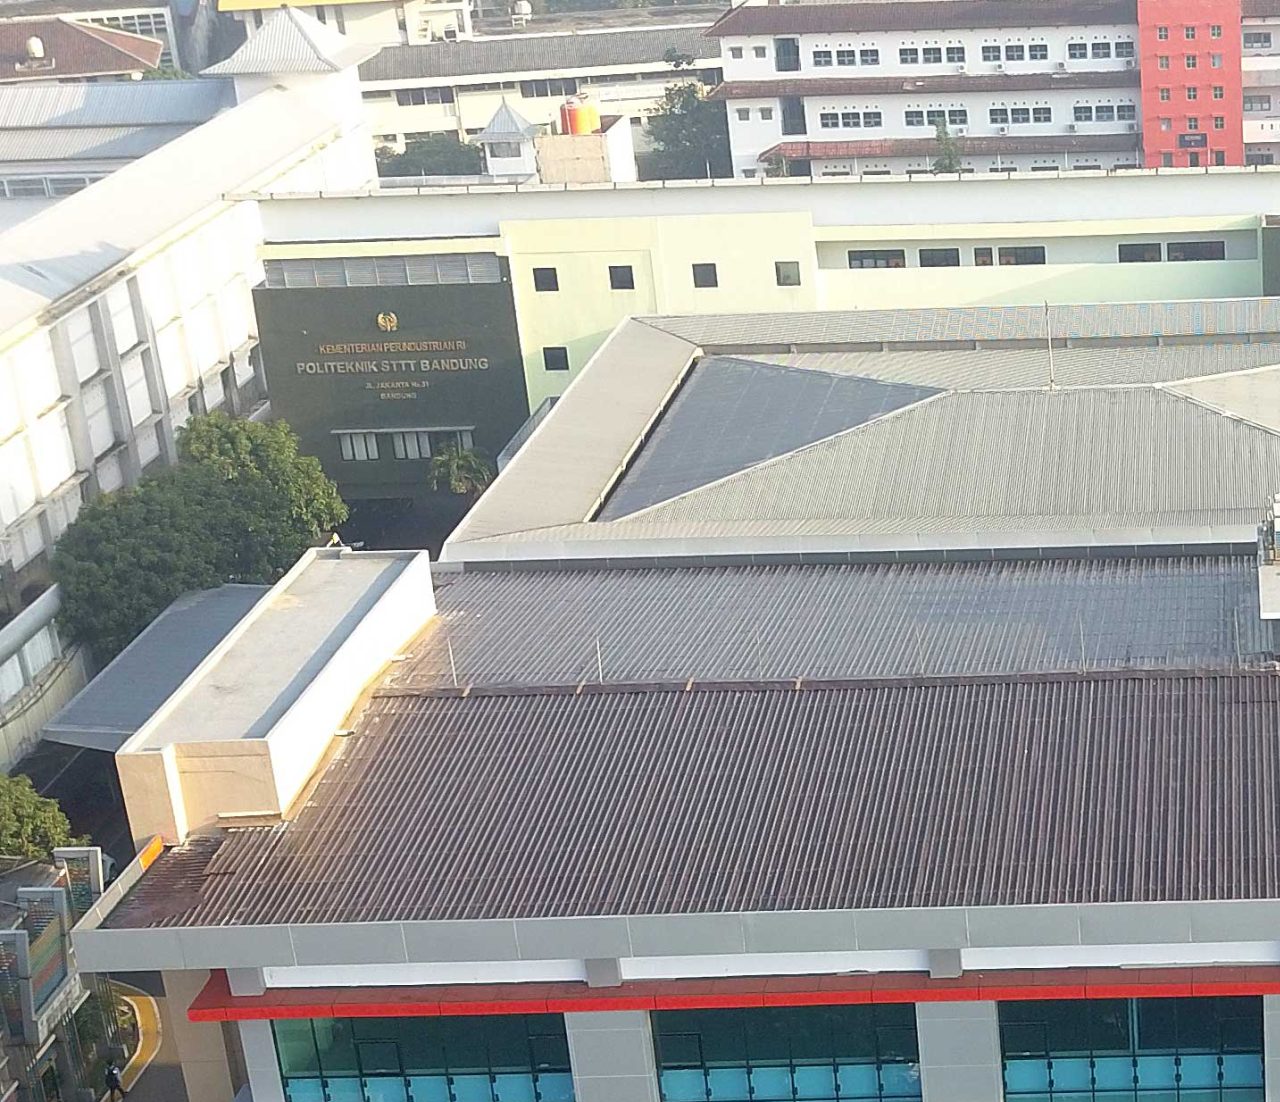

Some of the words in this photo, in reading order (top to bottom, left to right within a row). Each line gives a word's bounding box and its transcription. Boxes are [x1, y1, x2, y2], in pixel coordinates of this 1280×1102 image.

[319, 343, 383, 354] KEMENTERIAN
[456, 340, 466, 350] RI
[296, 360, 378, 374] POLITEKNIK
[381, 359, 417, 372] STTT
[420, 358, 489, 372] BANDUNG
